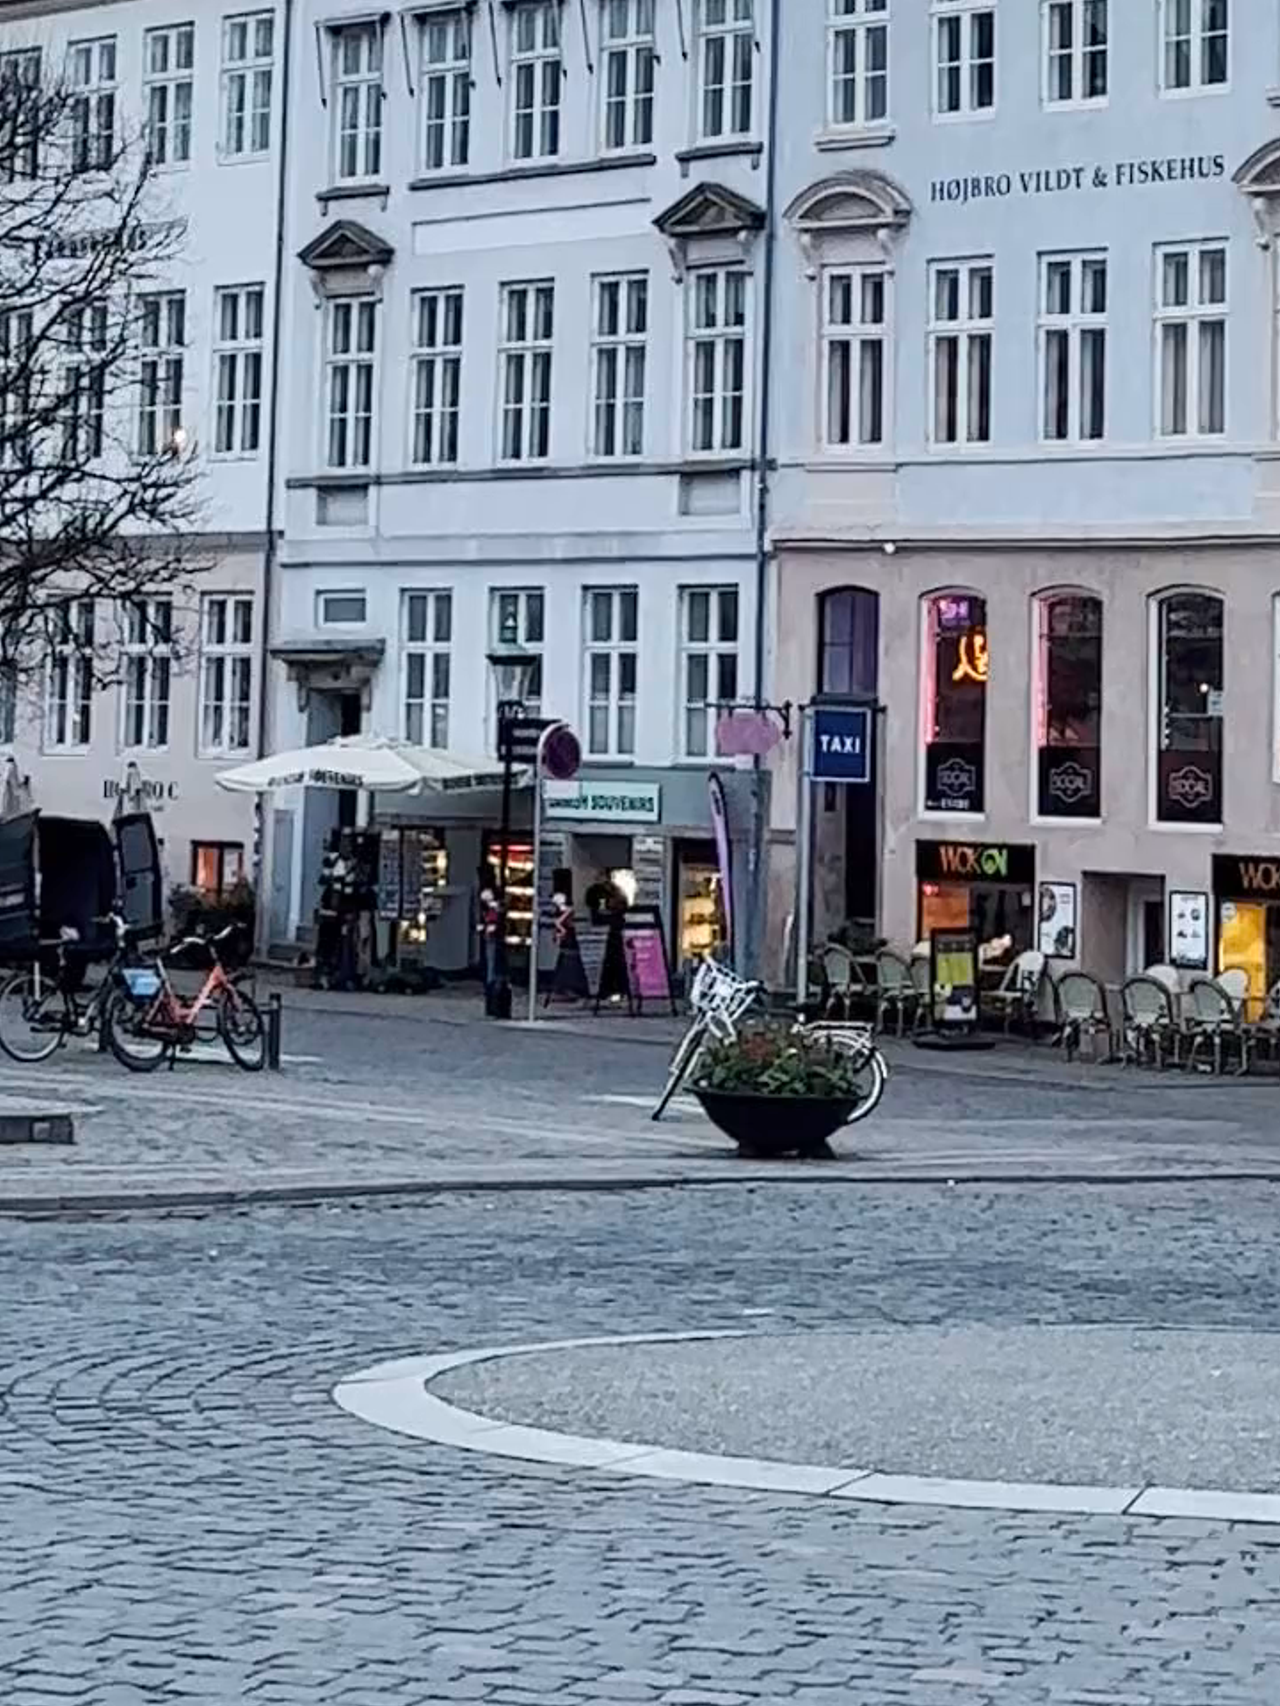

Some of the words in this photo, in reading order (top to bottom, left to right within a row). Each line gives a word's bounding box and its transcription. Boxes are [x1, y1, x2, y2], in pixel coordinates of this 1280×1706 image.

[930, 174, 1012, 205] HØJBRO
[1020, 166, 1085, 194] VILDT
[1091, 165, 1109, 188] &
[1116, 154, 1226, 187] FISKEHUS
[819, 734, 861, 754] TAXI
